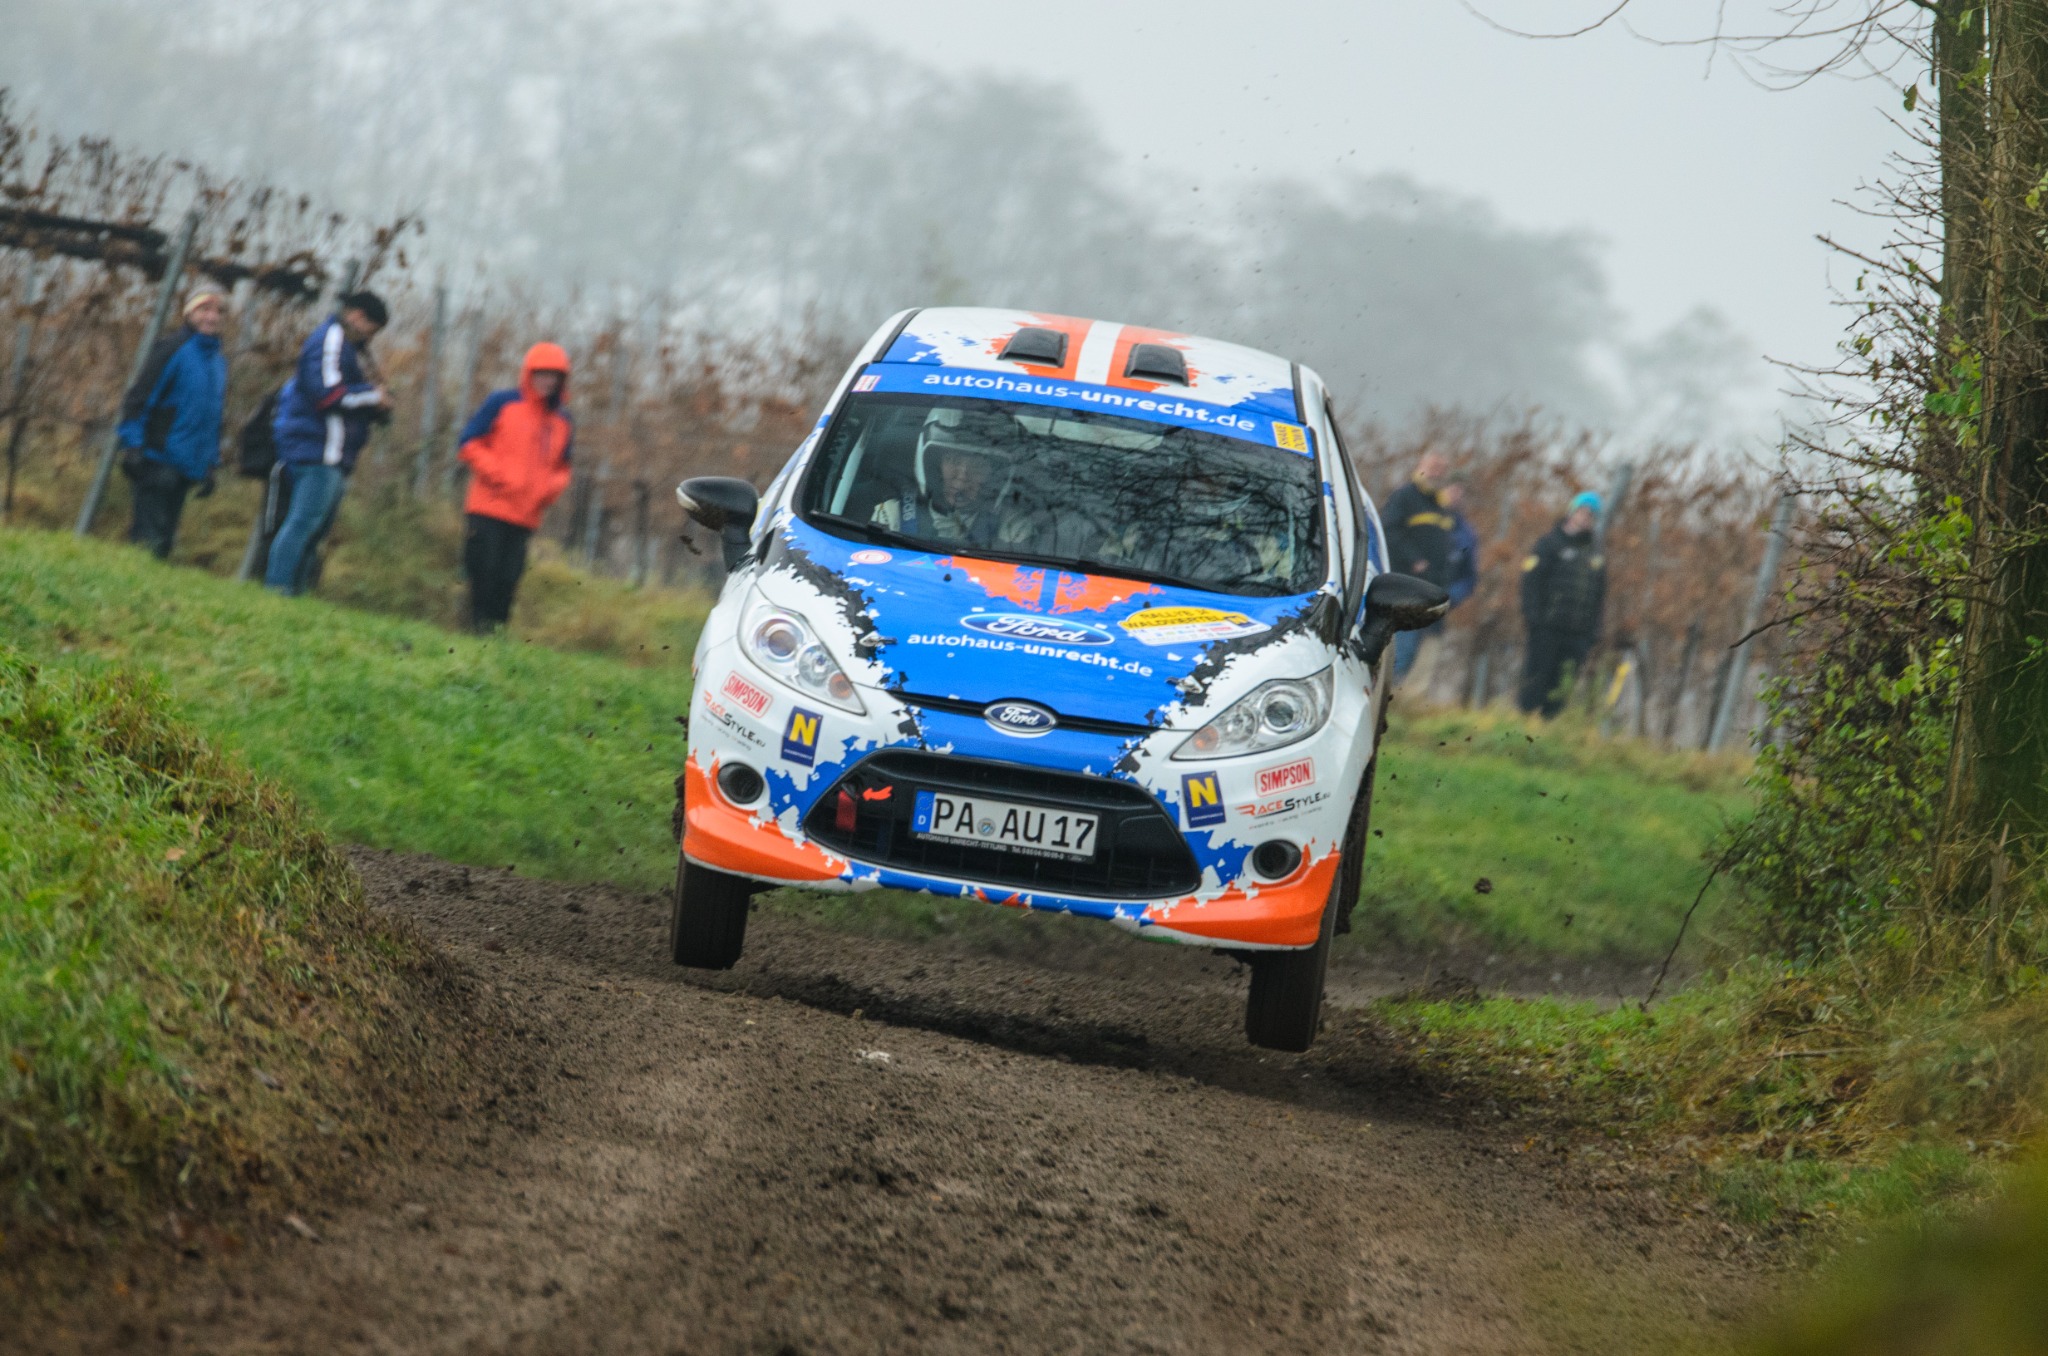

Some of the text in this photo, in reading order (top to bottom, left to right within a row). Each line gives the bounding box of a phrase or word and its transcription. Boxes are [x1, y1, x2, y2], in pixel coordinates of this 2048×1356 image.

[923, 373, 1256, 433] autohaus-unrecht.de
[981, 614, 1085, 643] Ford
[907, 632, 1153, 677] autohaus-unrecht.de
[723, 676, 769, 713] SIMPSON
[789, 713, 818, 747] N
[1000, 704, 1040, 728] Ford
[1188, 777, 1218, 808] N
[1260, 762, 1311, 793] SIMPSON
[917, 814, 926, 825] D
[933, 798, 1095, 850] PA AU 17
